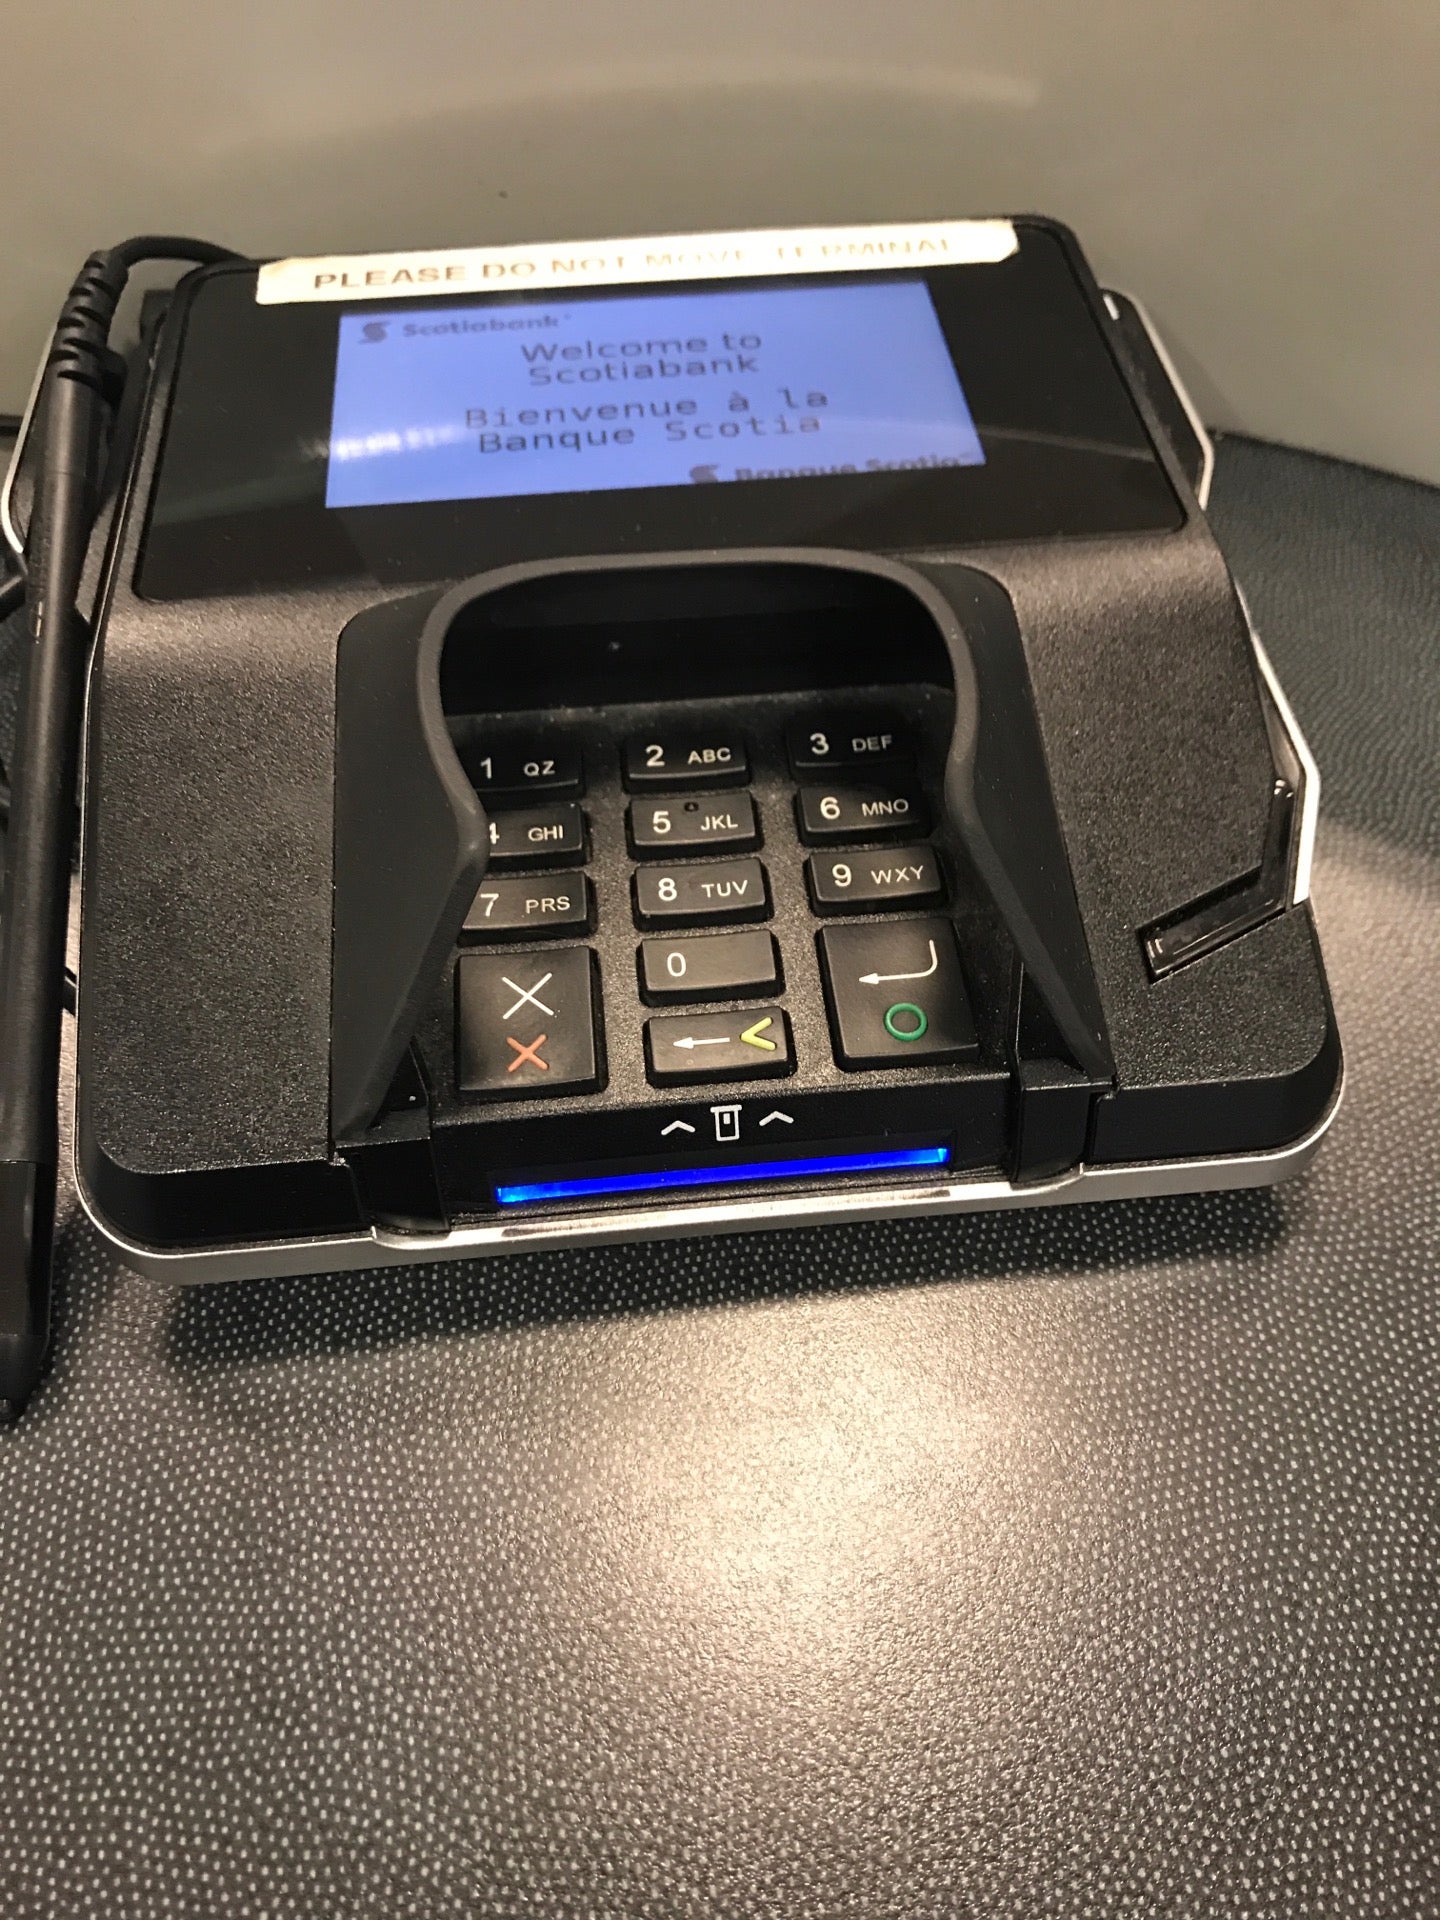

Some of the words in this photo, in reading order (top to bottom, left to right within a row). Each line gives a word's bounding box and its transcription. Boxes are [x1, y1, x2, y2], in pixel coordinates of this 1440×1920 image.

[313, 265, 466, 289] PLEASE
[482, 261, 537, 279] DO
[552, 255, 625, 274] NOT
[402, 315, 560, 338] Scotiabank
[520, 333, 708, 363] Welcome
[723, 331, 762, 352] to
[528, 353, 760, 386] Scotiabank
[466, 398, 698, 429] Bienvenue
[728, 391, 750, 413] à
[777, 386, 829, 408] la
[479, 425, 636, 453] Banque
[665, 414, 822, 441] Scotia
[645, 744, 666, 767] 2
[687, 746, 732, 765] ABC
[809, 732, 830, 755] 3
[852, 734, 894, 752] DEF
[480, 756, 493, 779] 1
[523, 760, 556, 777] QZ
[820, 796, 841, 820] 6
[861, 798, 910, 817] MNO
[527, 824, 564, 842] GHI
[652, 810, 672, 834] 5
[700, 814, 739, 831] JKL
[831, 863, 852, 888] 9
[870, 864, 925, 885] WXY
[657, 877, 678, 902] 8
[701, 879, 749, 899] TUV
[480, 893, 500, 917] 7
[525, 896, 571, 915] PRS
[666, 951, 687, 977] 0
